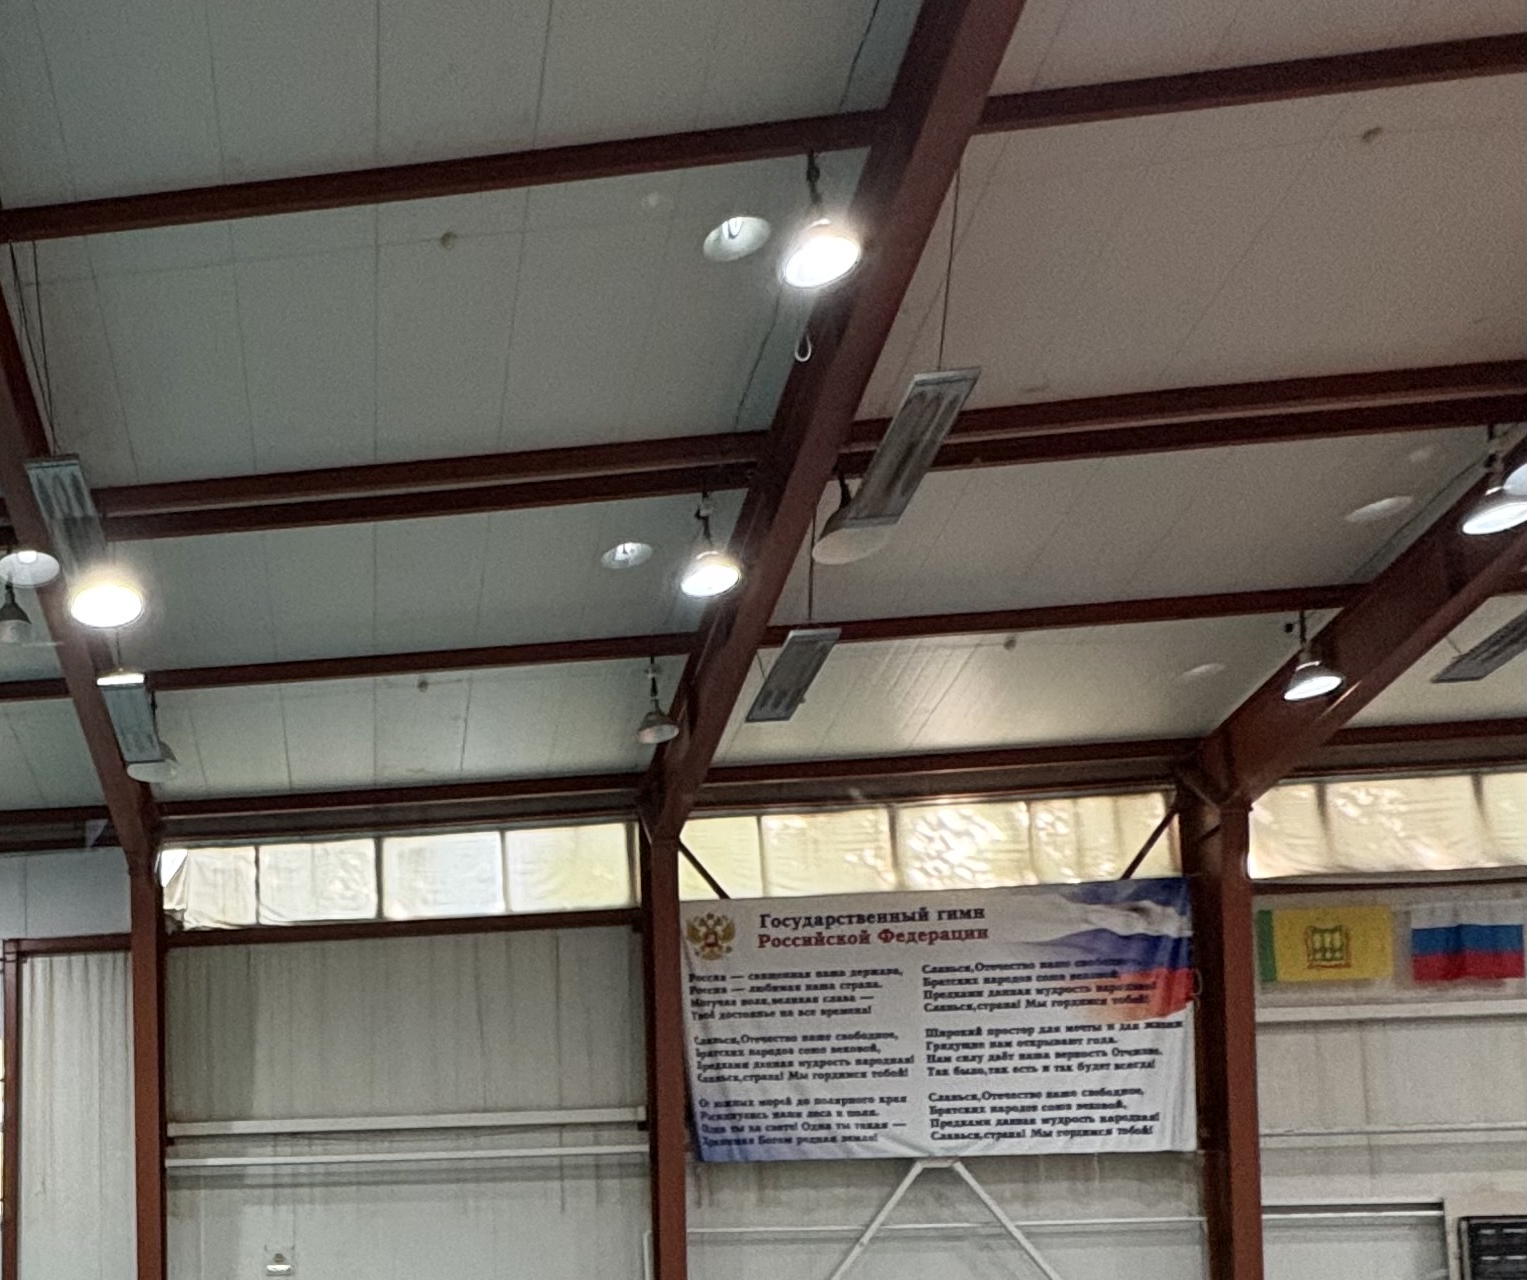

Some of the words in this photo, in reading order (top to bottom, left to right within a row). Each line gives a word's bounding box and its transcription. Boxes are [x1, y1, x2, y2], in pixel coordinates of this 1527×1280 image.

[759, 907, 930, 929] Государственный
[937, 906, 985, 921] гимн
[757, 929, 872, 949] Российской
[877, 928, 989, 945] Федерации
